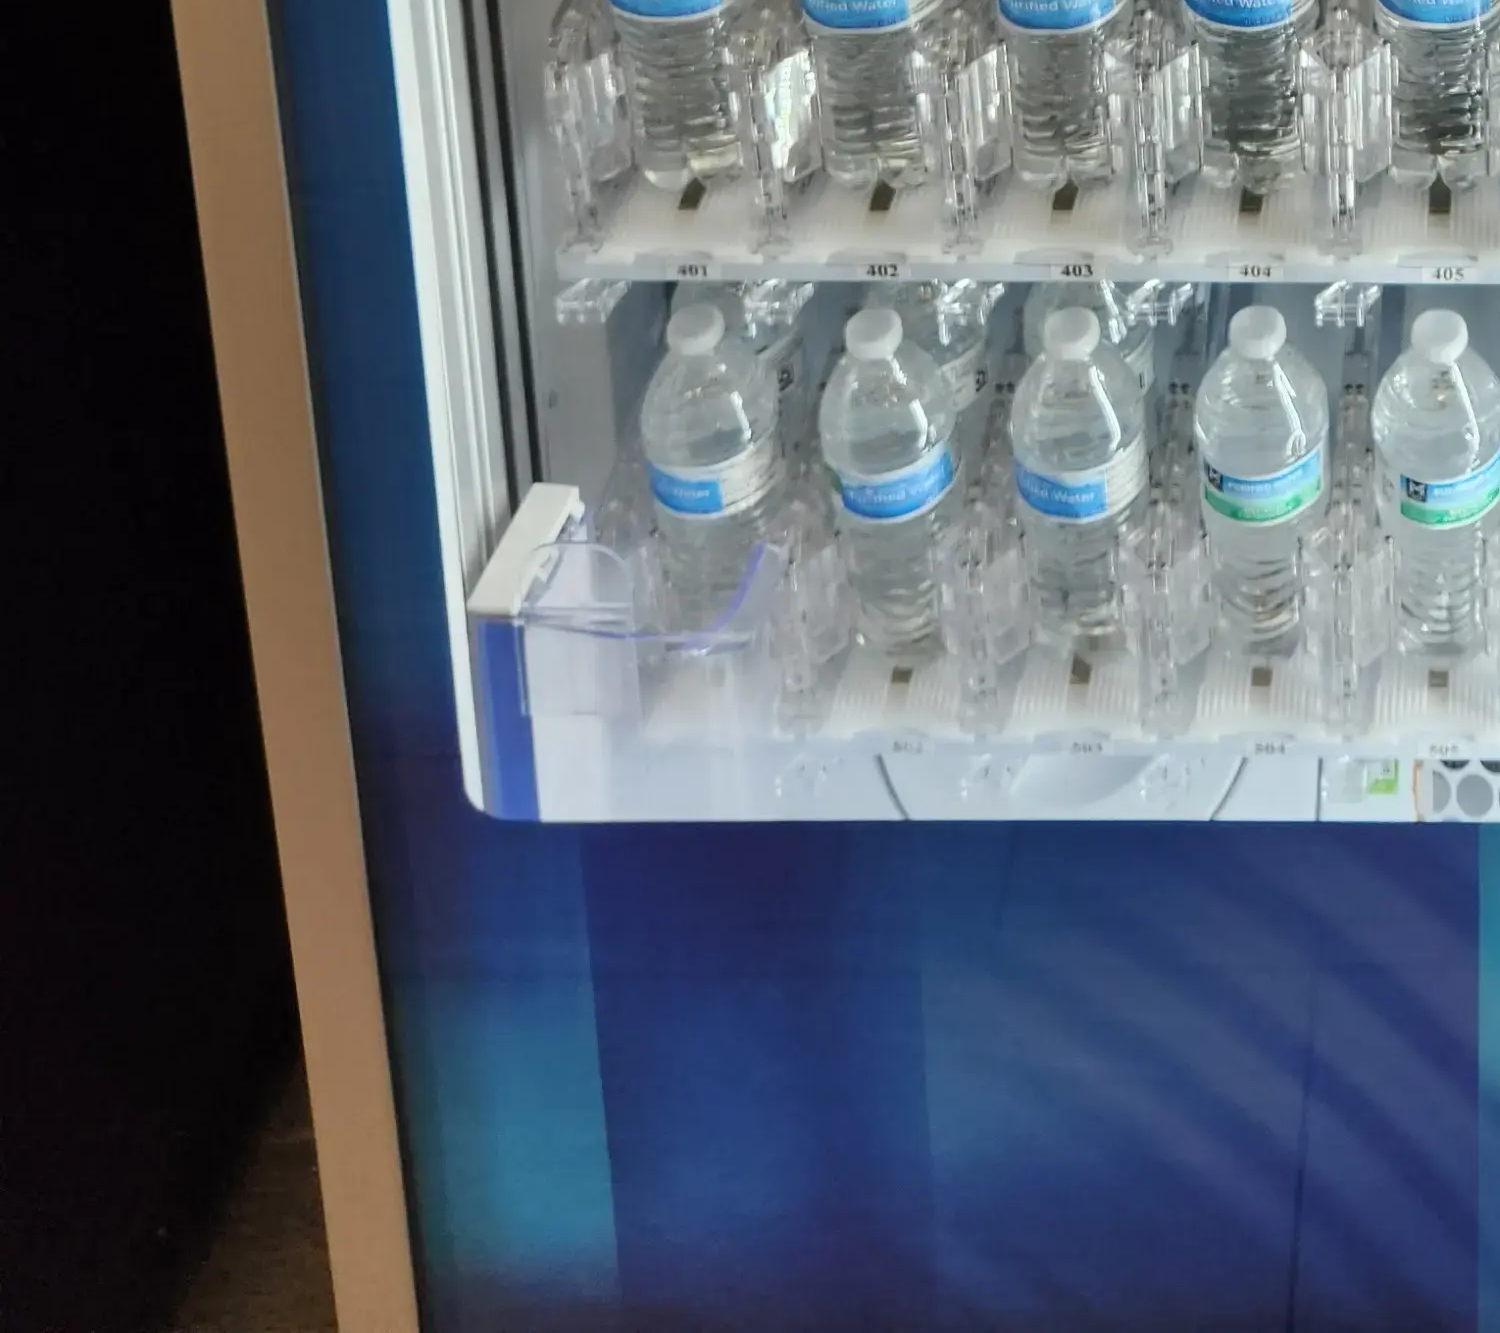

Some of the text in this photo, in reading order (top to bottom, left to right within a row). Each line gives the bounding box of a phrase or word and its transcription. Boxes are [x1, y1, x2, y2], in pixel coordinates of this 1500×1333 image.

[678, 265, 707, 277] 401
[867, 265, 898, 277] 402
[1061, 264, 1093, 277] 403
[1240, 266, 1272, 278] 404
[1433, 268, 1465, 280] 405
